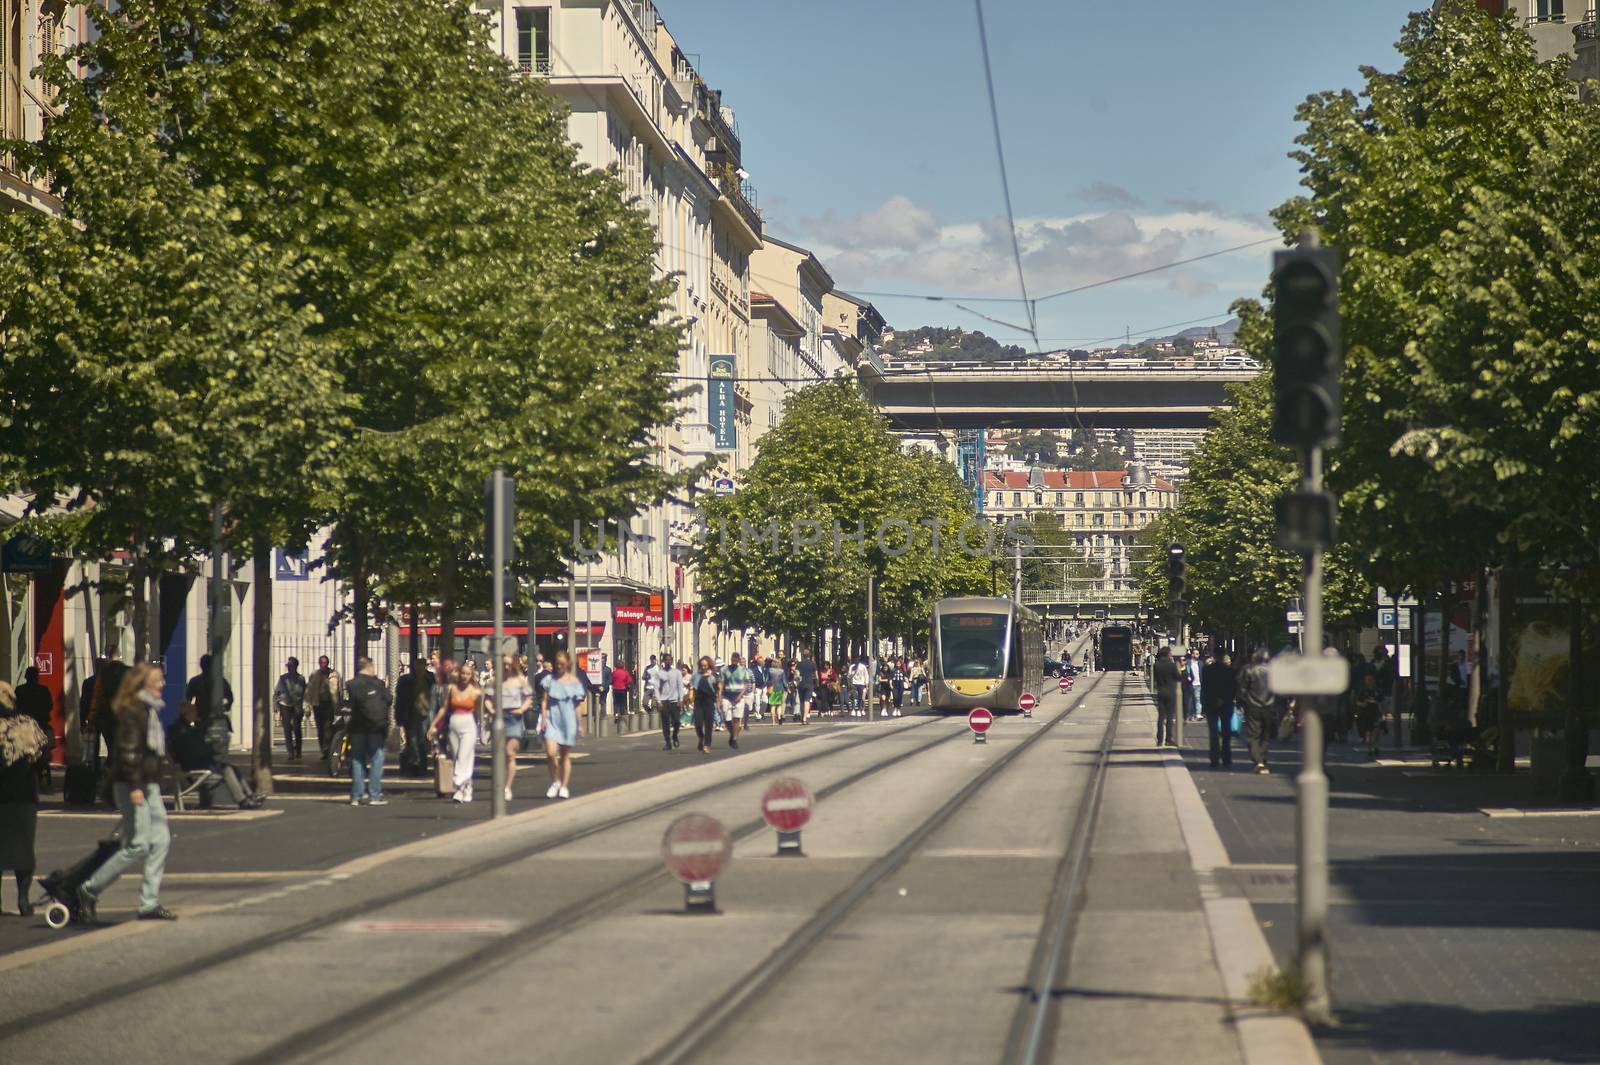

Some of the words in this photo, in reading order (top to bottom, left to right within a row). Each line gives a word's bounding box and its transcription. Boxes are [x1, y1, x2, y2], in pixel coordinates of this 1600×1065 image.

[718, 381, 726, 407] ALBA
[1463, 581, 1476, 591] SF
[617, 610, 643, 619] Malongo
[1384, 613, 1393, 624] P
